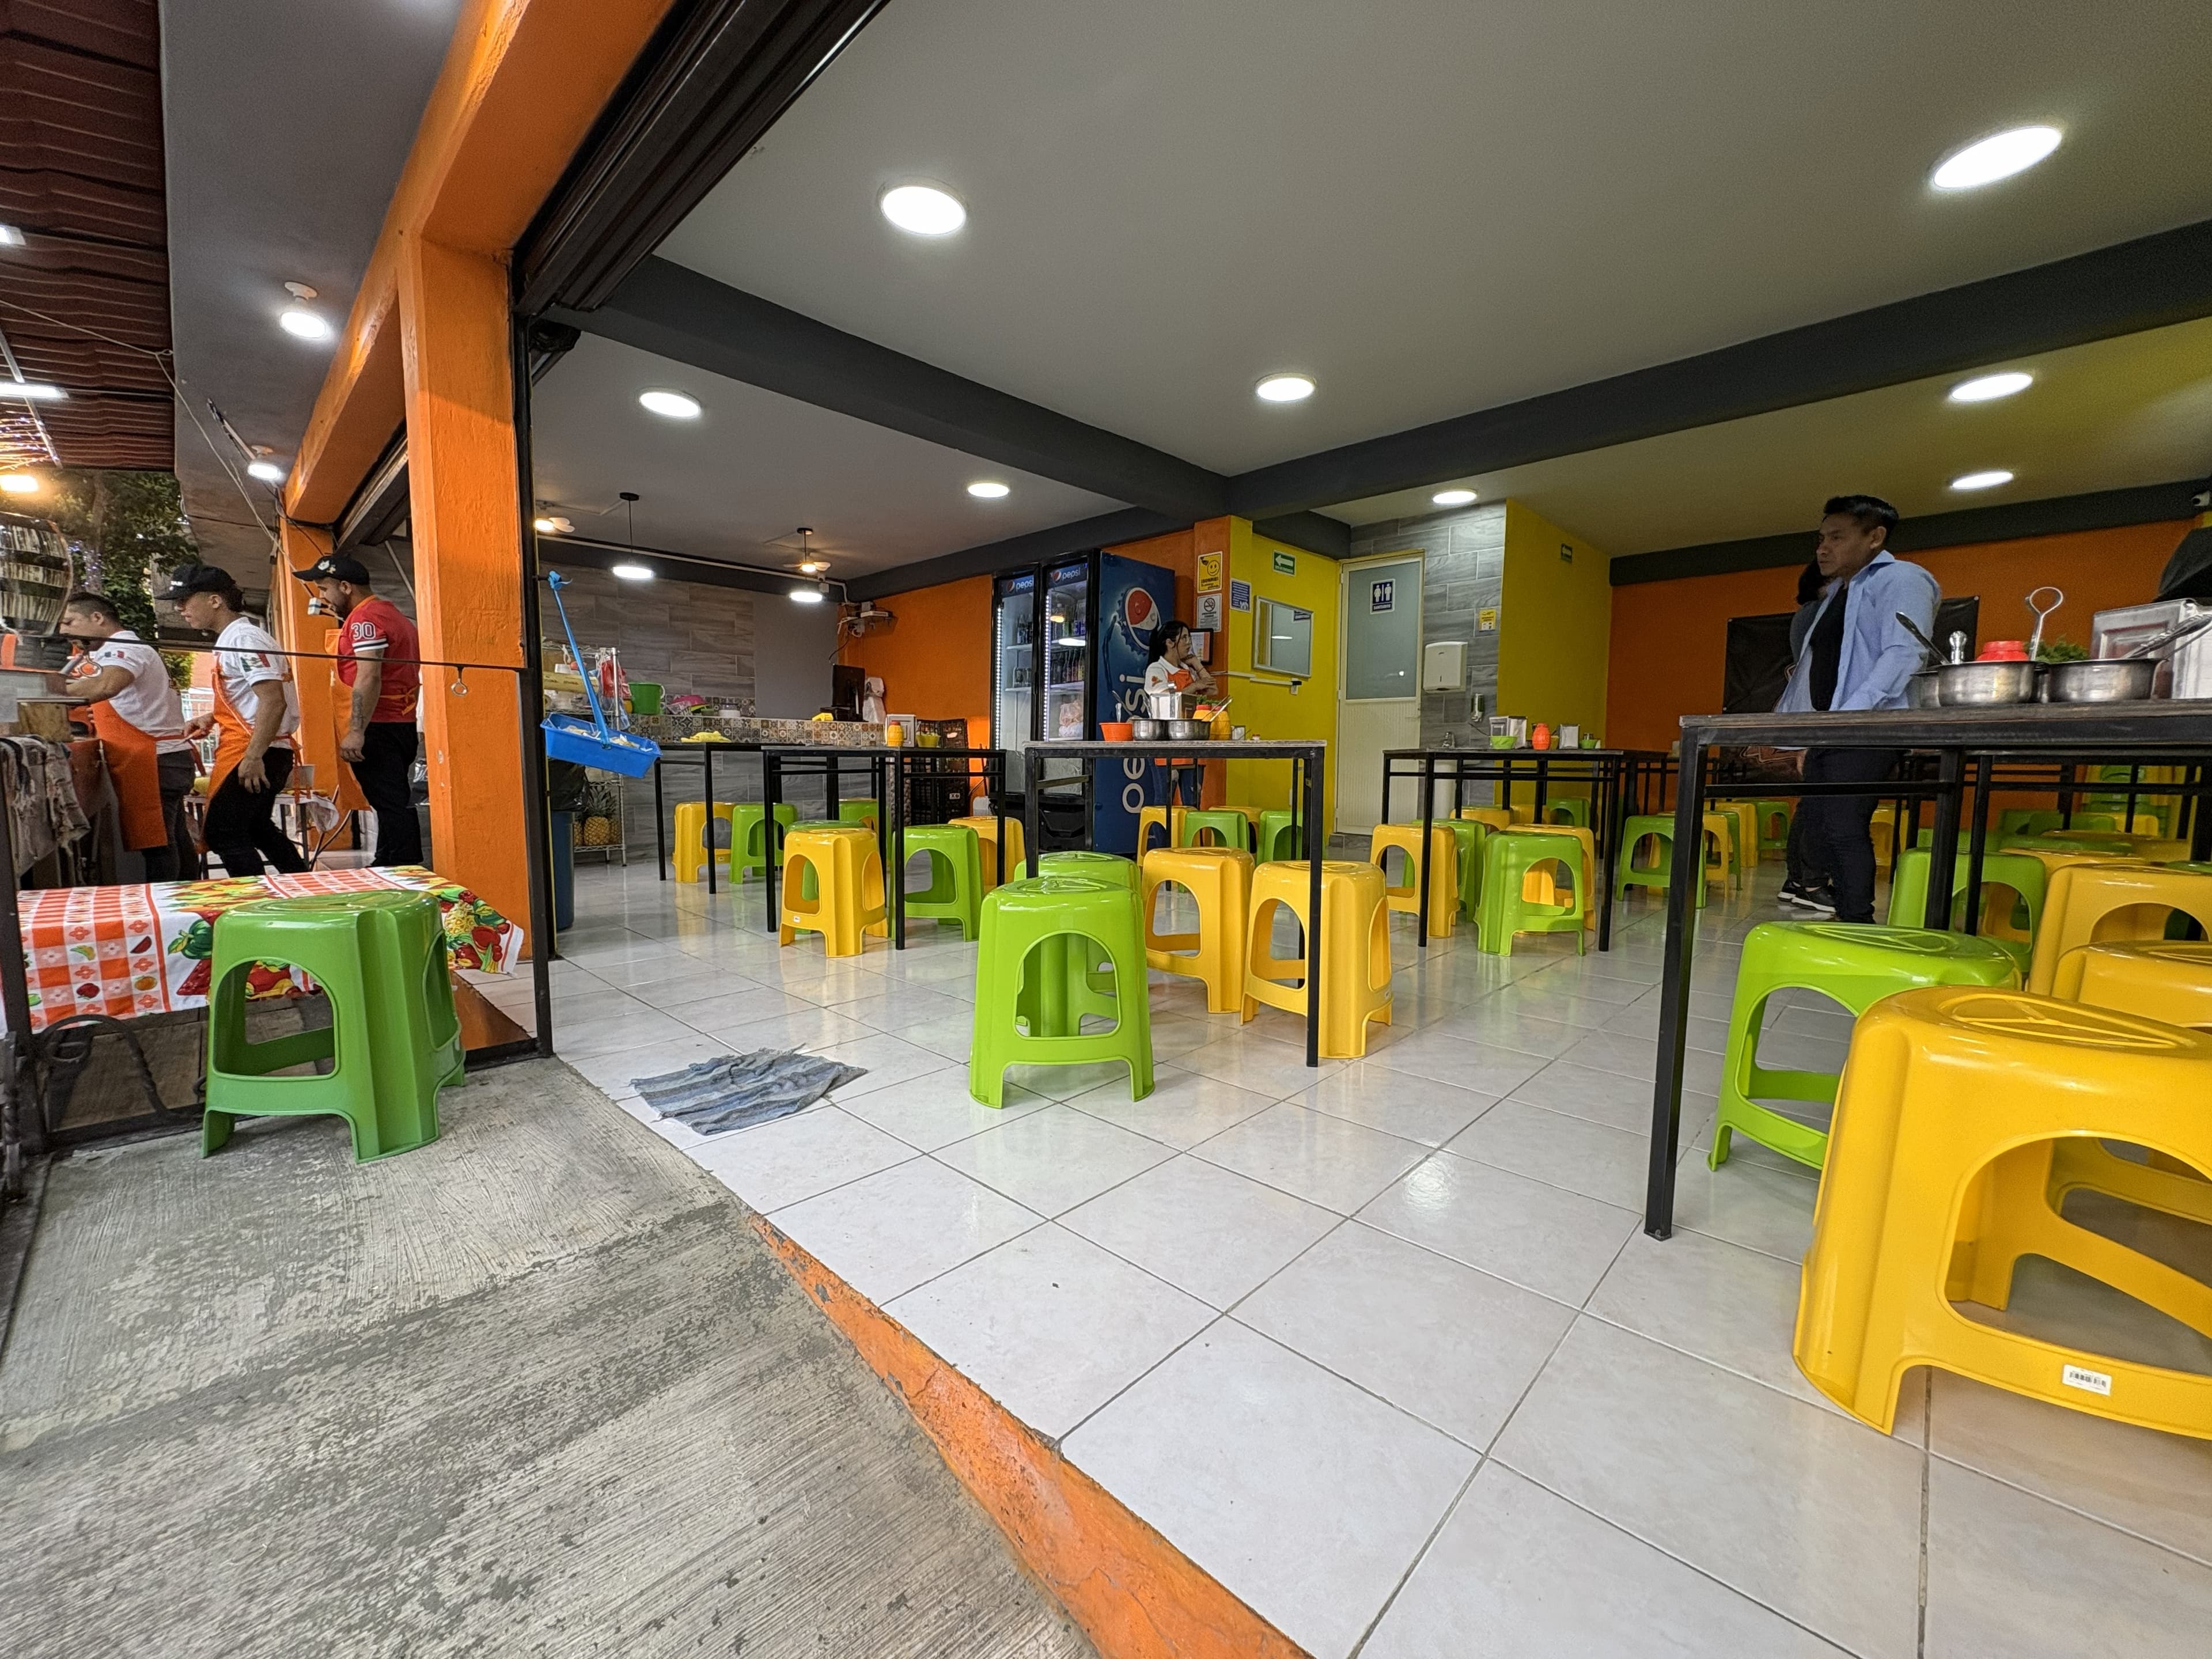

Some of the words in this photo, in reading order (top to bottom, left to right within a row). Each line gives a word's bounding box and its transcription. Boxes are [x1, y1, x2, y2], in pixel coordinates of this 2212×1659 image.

[1062, 567, 1081, 581] pepsi
[1016, 579, 1033, 592] pepsi
[351, 622, 376, 641] 30
